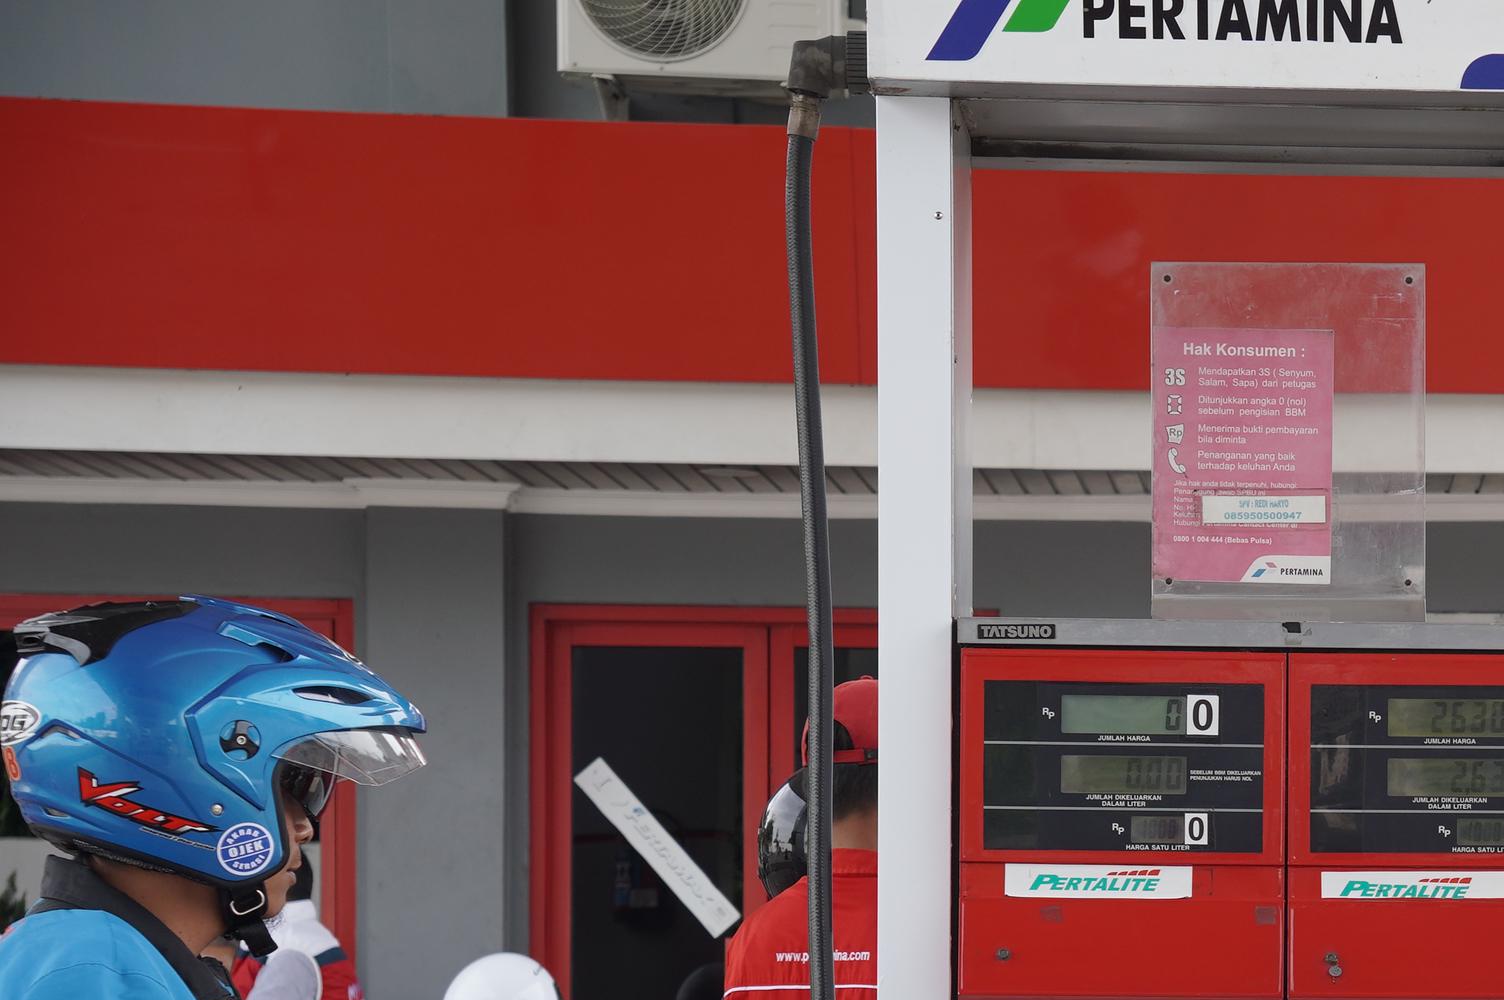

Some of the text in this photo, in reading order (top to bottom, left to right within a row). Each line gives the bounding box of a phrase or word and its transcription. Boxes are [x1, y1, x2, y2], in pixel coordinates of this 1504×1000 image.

[1082, 0, 1403, 44] PERTAMINA
[1183, 343, 1296, 357] Hak Konsumen
[1165, 368, 1186, 386] 3S
[1198, 368, 1317, 378] Mendapatkan 3S Senyum,
[1198, 378, 1317, 389] Salam, Sapa) dari petugas
[1198, 396, 1307, 407] Ditunjukkan angka 0 (nol)
[1198, 407, 1306, 418] sebelum pengisian BBM
[1169, 428, 1183, 439] Rp
[1198, 424, 1319, 436] Menerima bukti pembayaran
[1198, 435, 1247, 445] bila diminta
[1198, 451, 1296, 462] Penanganan yang baik
[1197, 462, 1296, 473] terhadap keluhan Anda
[1220, 480, 1235, 488] tidak
[1224, 511, 1302, 520] 085950500947
[1224, 536, 1249, 544] (Bebas
[1250, 537, 1272, 545] Pulsa)
[1280, 568, 1323, 577] PERTAMINA
[981, 624, 1053, 639] TATSUNO
[1192, 698, 1214, 732] 0
[1126, 735, 1151, 743] HARGA
[77, 766, 224, 836] VOLT
[1085, 793, 1113, 801] JUMLAH
[1101, 800, 1146, 808] DALAM LITER
[1188, 816, 1205, 841] 0
[227, 839, 266, 858] OJEK
[1029, 874, 1161, 892] PERTALITE
[1340, 880, 1473, 900] PERTALITE
[775, 949, 870, 964] www.pina.com
